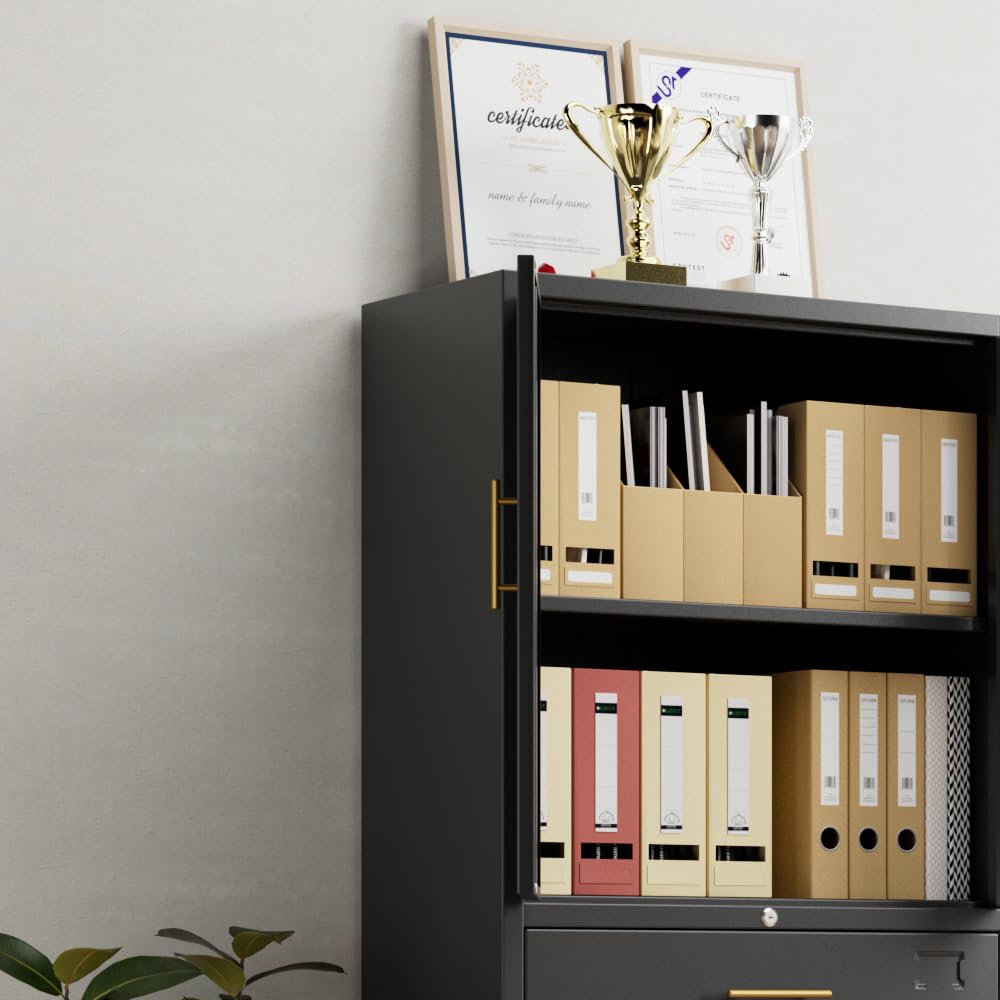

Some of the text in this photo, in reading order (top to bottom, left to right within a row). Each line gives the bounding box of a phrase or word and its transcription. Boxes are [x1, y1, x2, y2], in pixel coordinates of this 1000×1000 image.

[700, 91, 741, 103] CERTIFICATE
[487, 106, 576, 133] certificate
[487, 192, 514, 202] name
[529, 192, 564, 211] family
[564, 199, 592, 209] name
